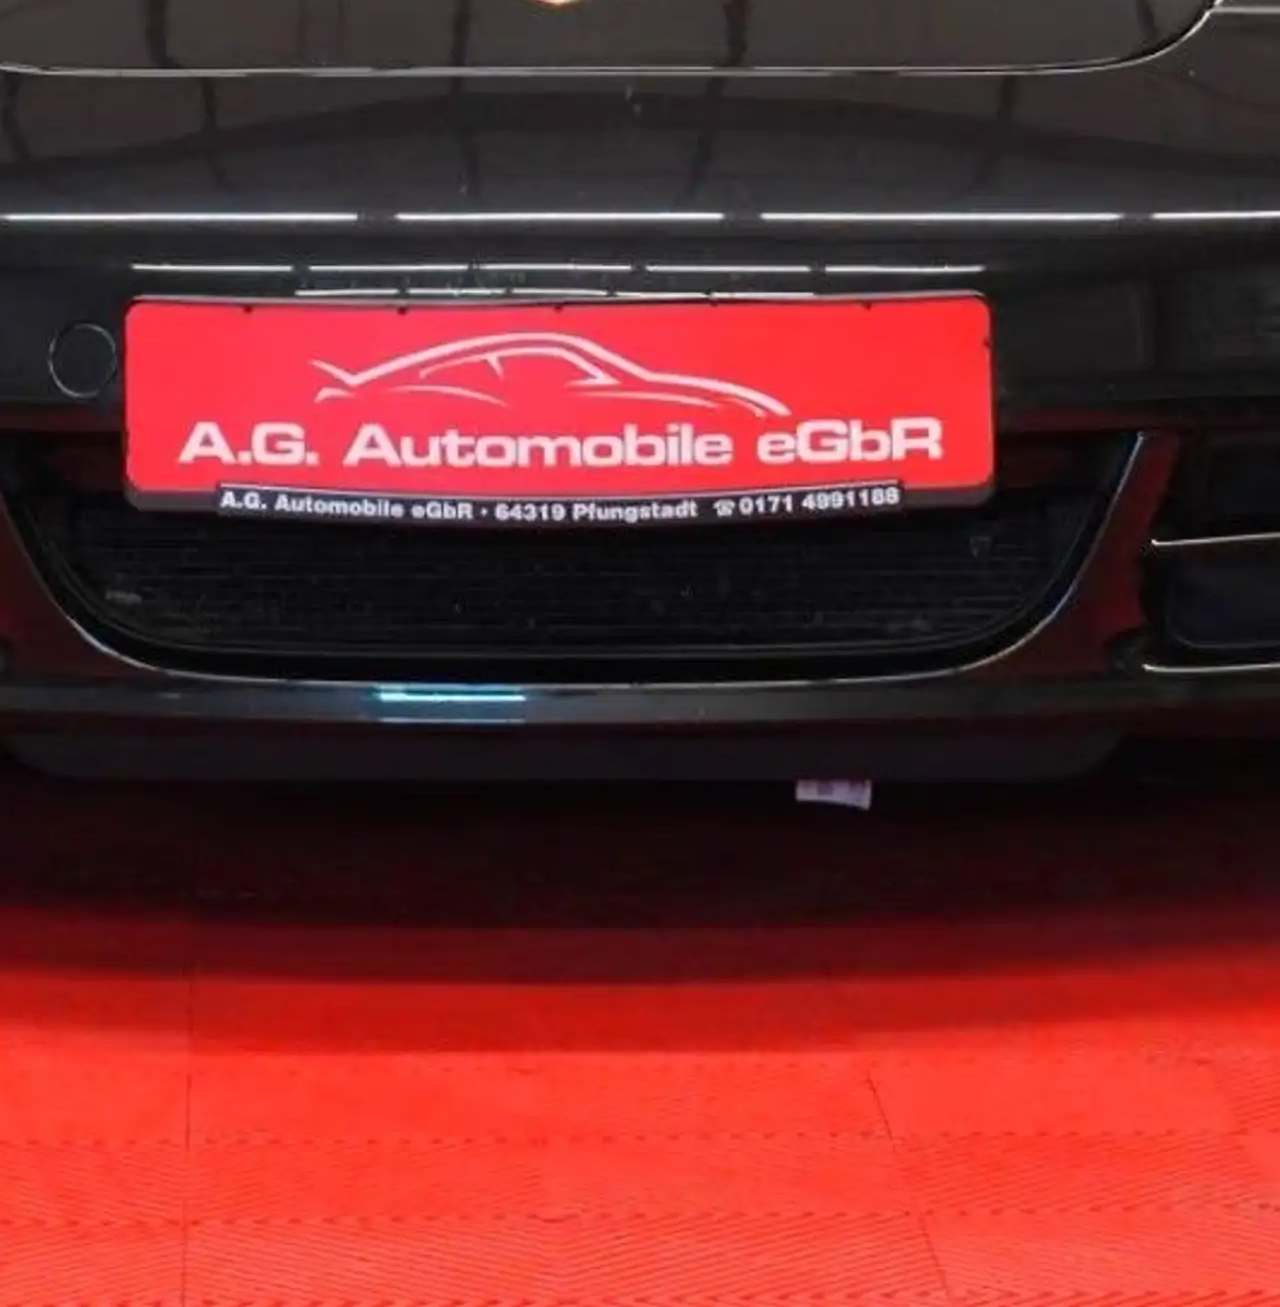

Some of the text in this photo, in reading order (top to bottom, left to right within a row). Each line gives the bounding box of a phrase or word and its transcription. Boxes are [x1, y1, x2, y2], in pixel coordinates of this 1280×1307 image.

[178, 416, 943, 467] A.G. Automobile eGbR
[220, 490, 268, 510] A.G.
[273, 493, 404, 519] Automobile
[410, 501, 473, 520] eGbR
[494, 502, 566, 522] 64319
[573, 498, 699, 524] Pfungstadt
[738, 493, 794, 516] 0171
